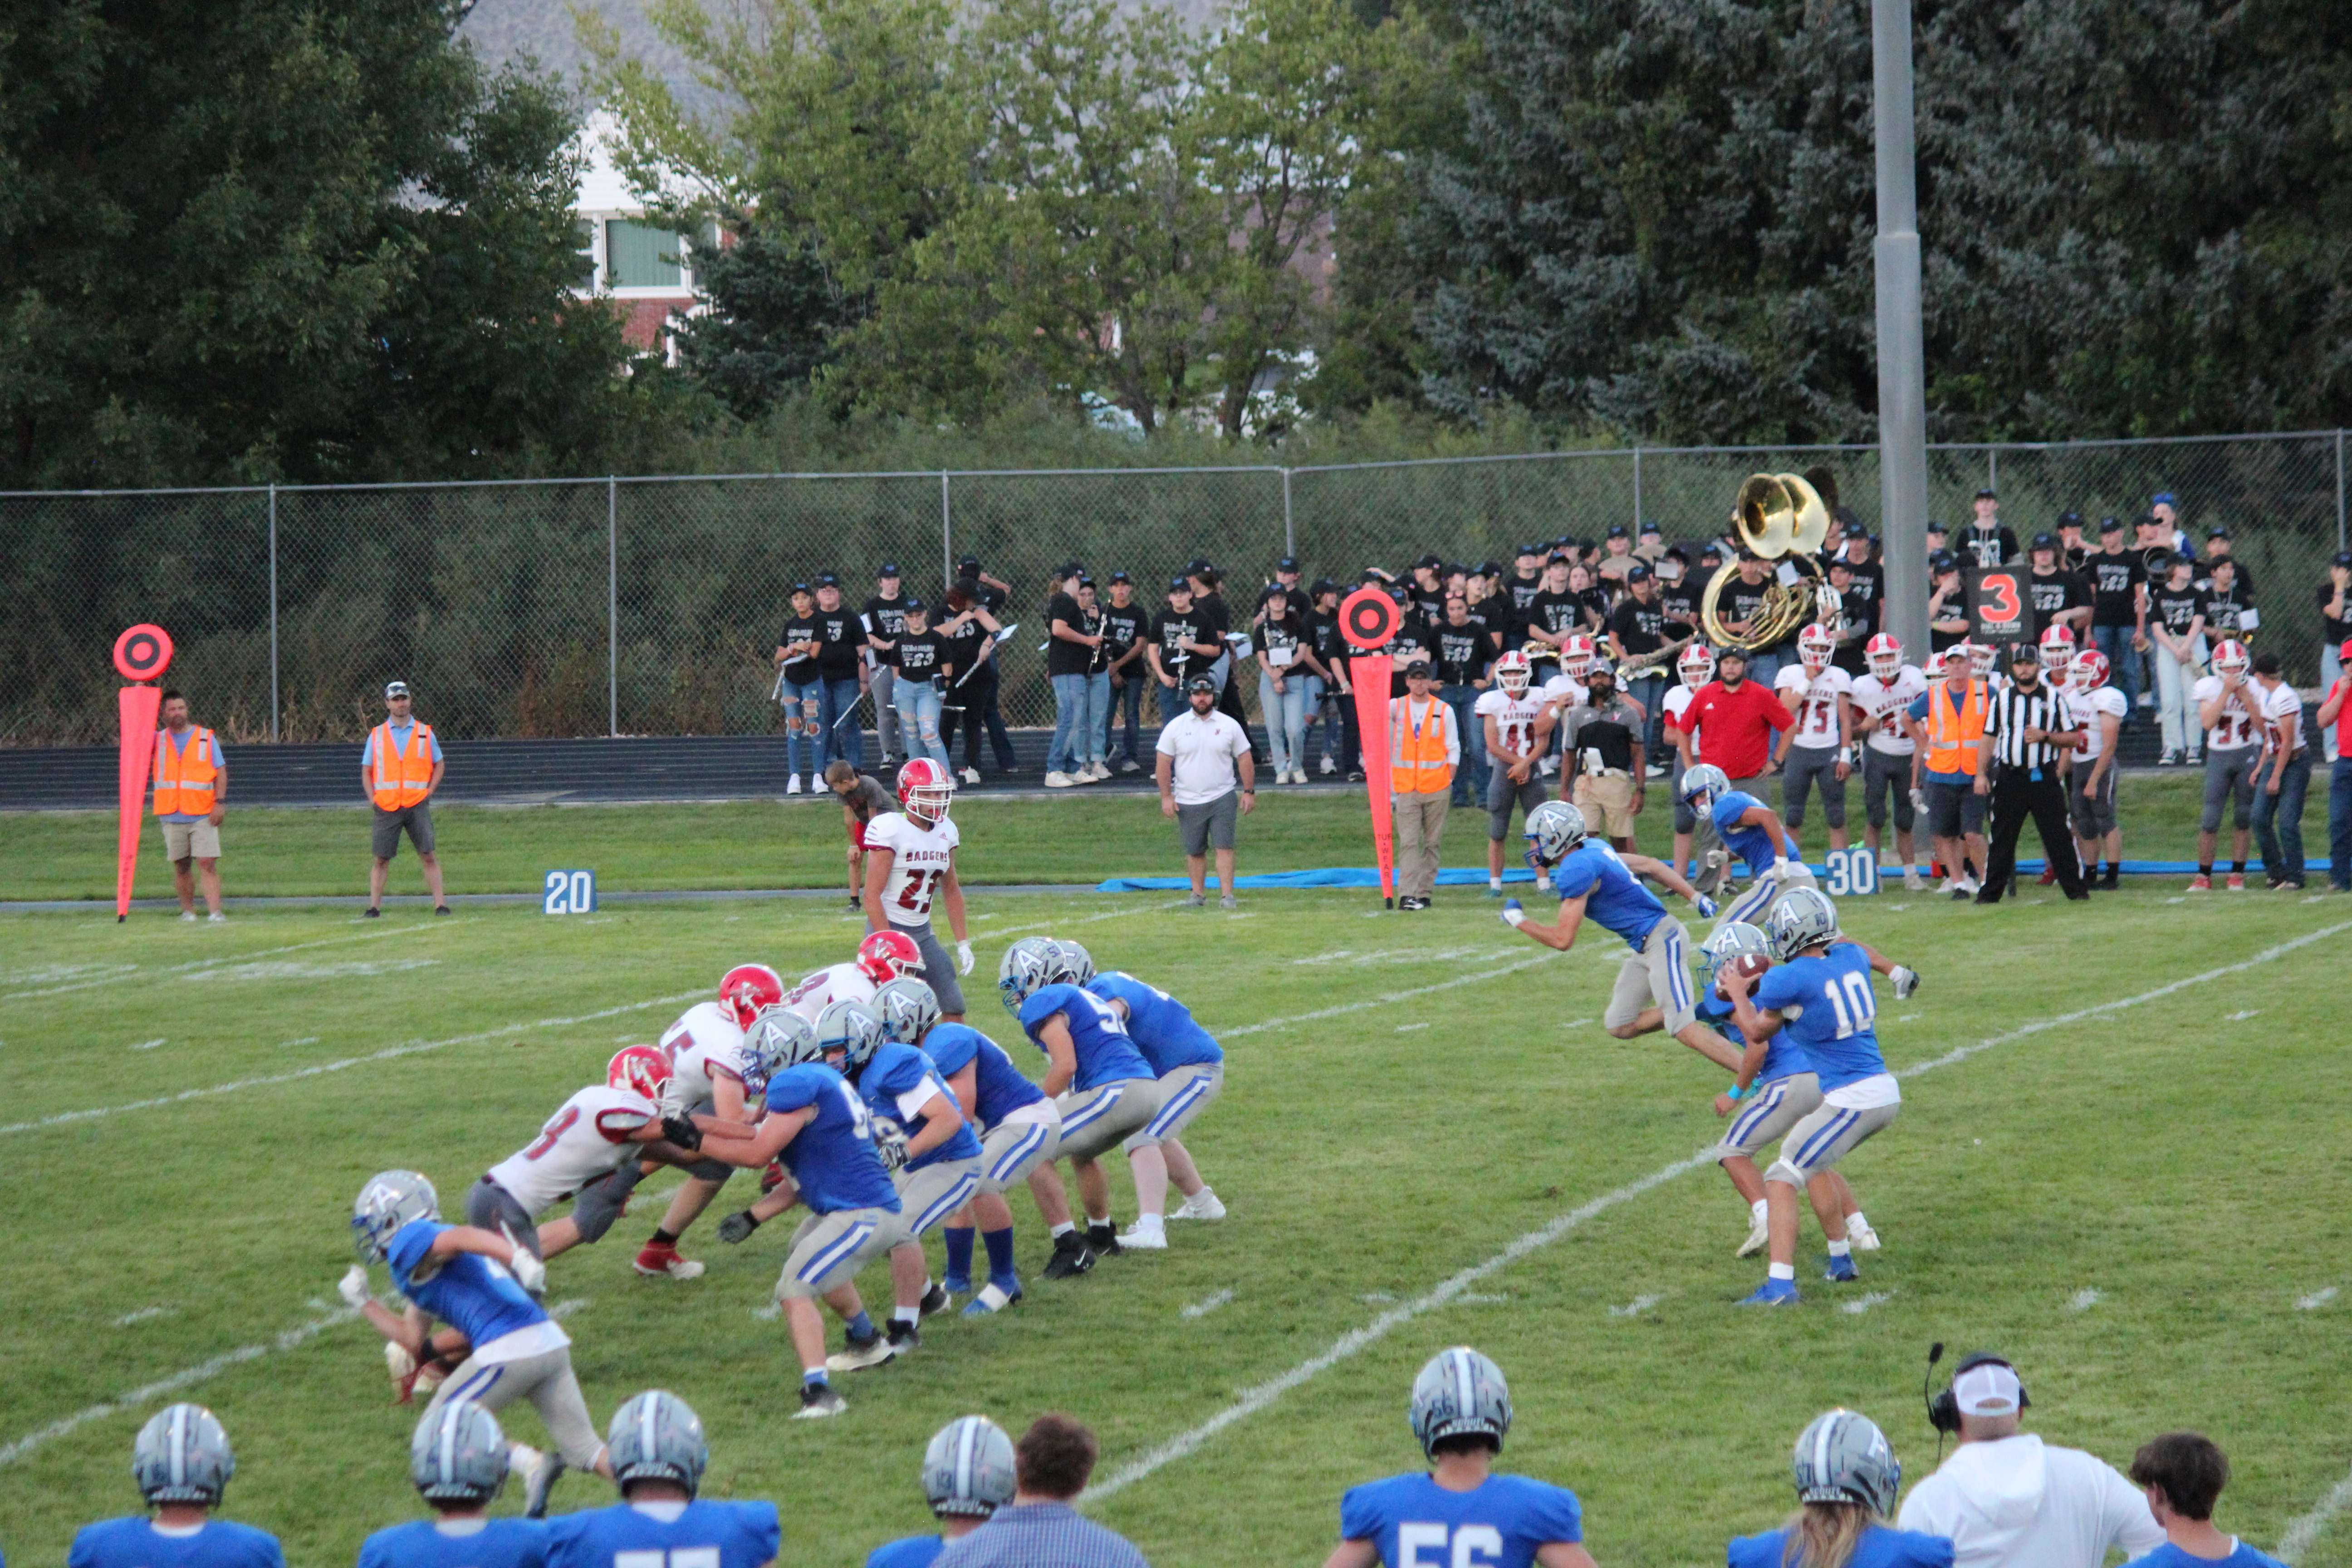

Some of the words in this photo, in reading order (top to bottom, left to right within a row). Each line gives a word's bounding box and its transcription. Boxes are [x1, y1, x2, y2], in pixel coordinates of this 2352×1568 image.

[1979, 573, 2021, 622] 3
[1543, 808, 1568, 832] A
[906, 850, 948, 863] BADGERS
[1827, 849, 1874, 896] 30
[545, 871, 591, 914] 20
[1781, 900, 1802, 930] A
[1721, 927, 1743, 954] A
[1015, 948, 1044, 978] A
[888, 989, 917, 1019] A
[1824, 970, 1876, 1040] 10
[764, 1021, 791, 1053] A
[847, 1008, 877, 1040] A
